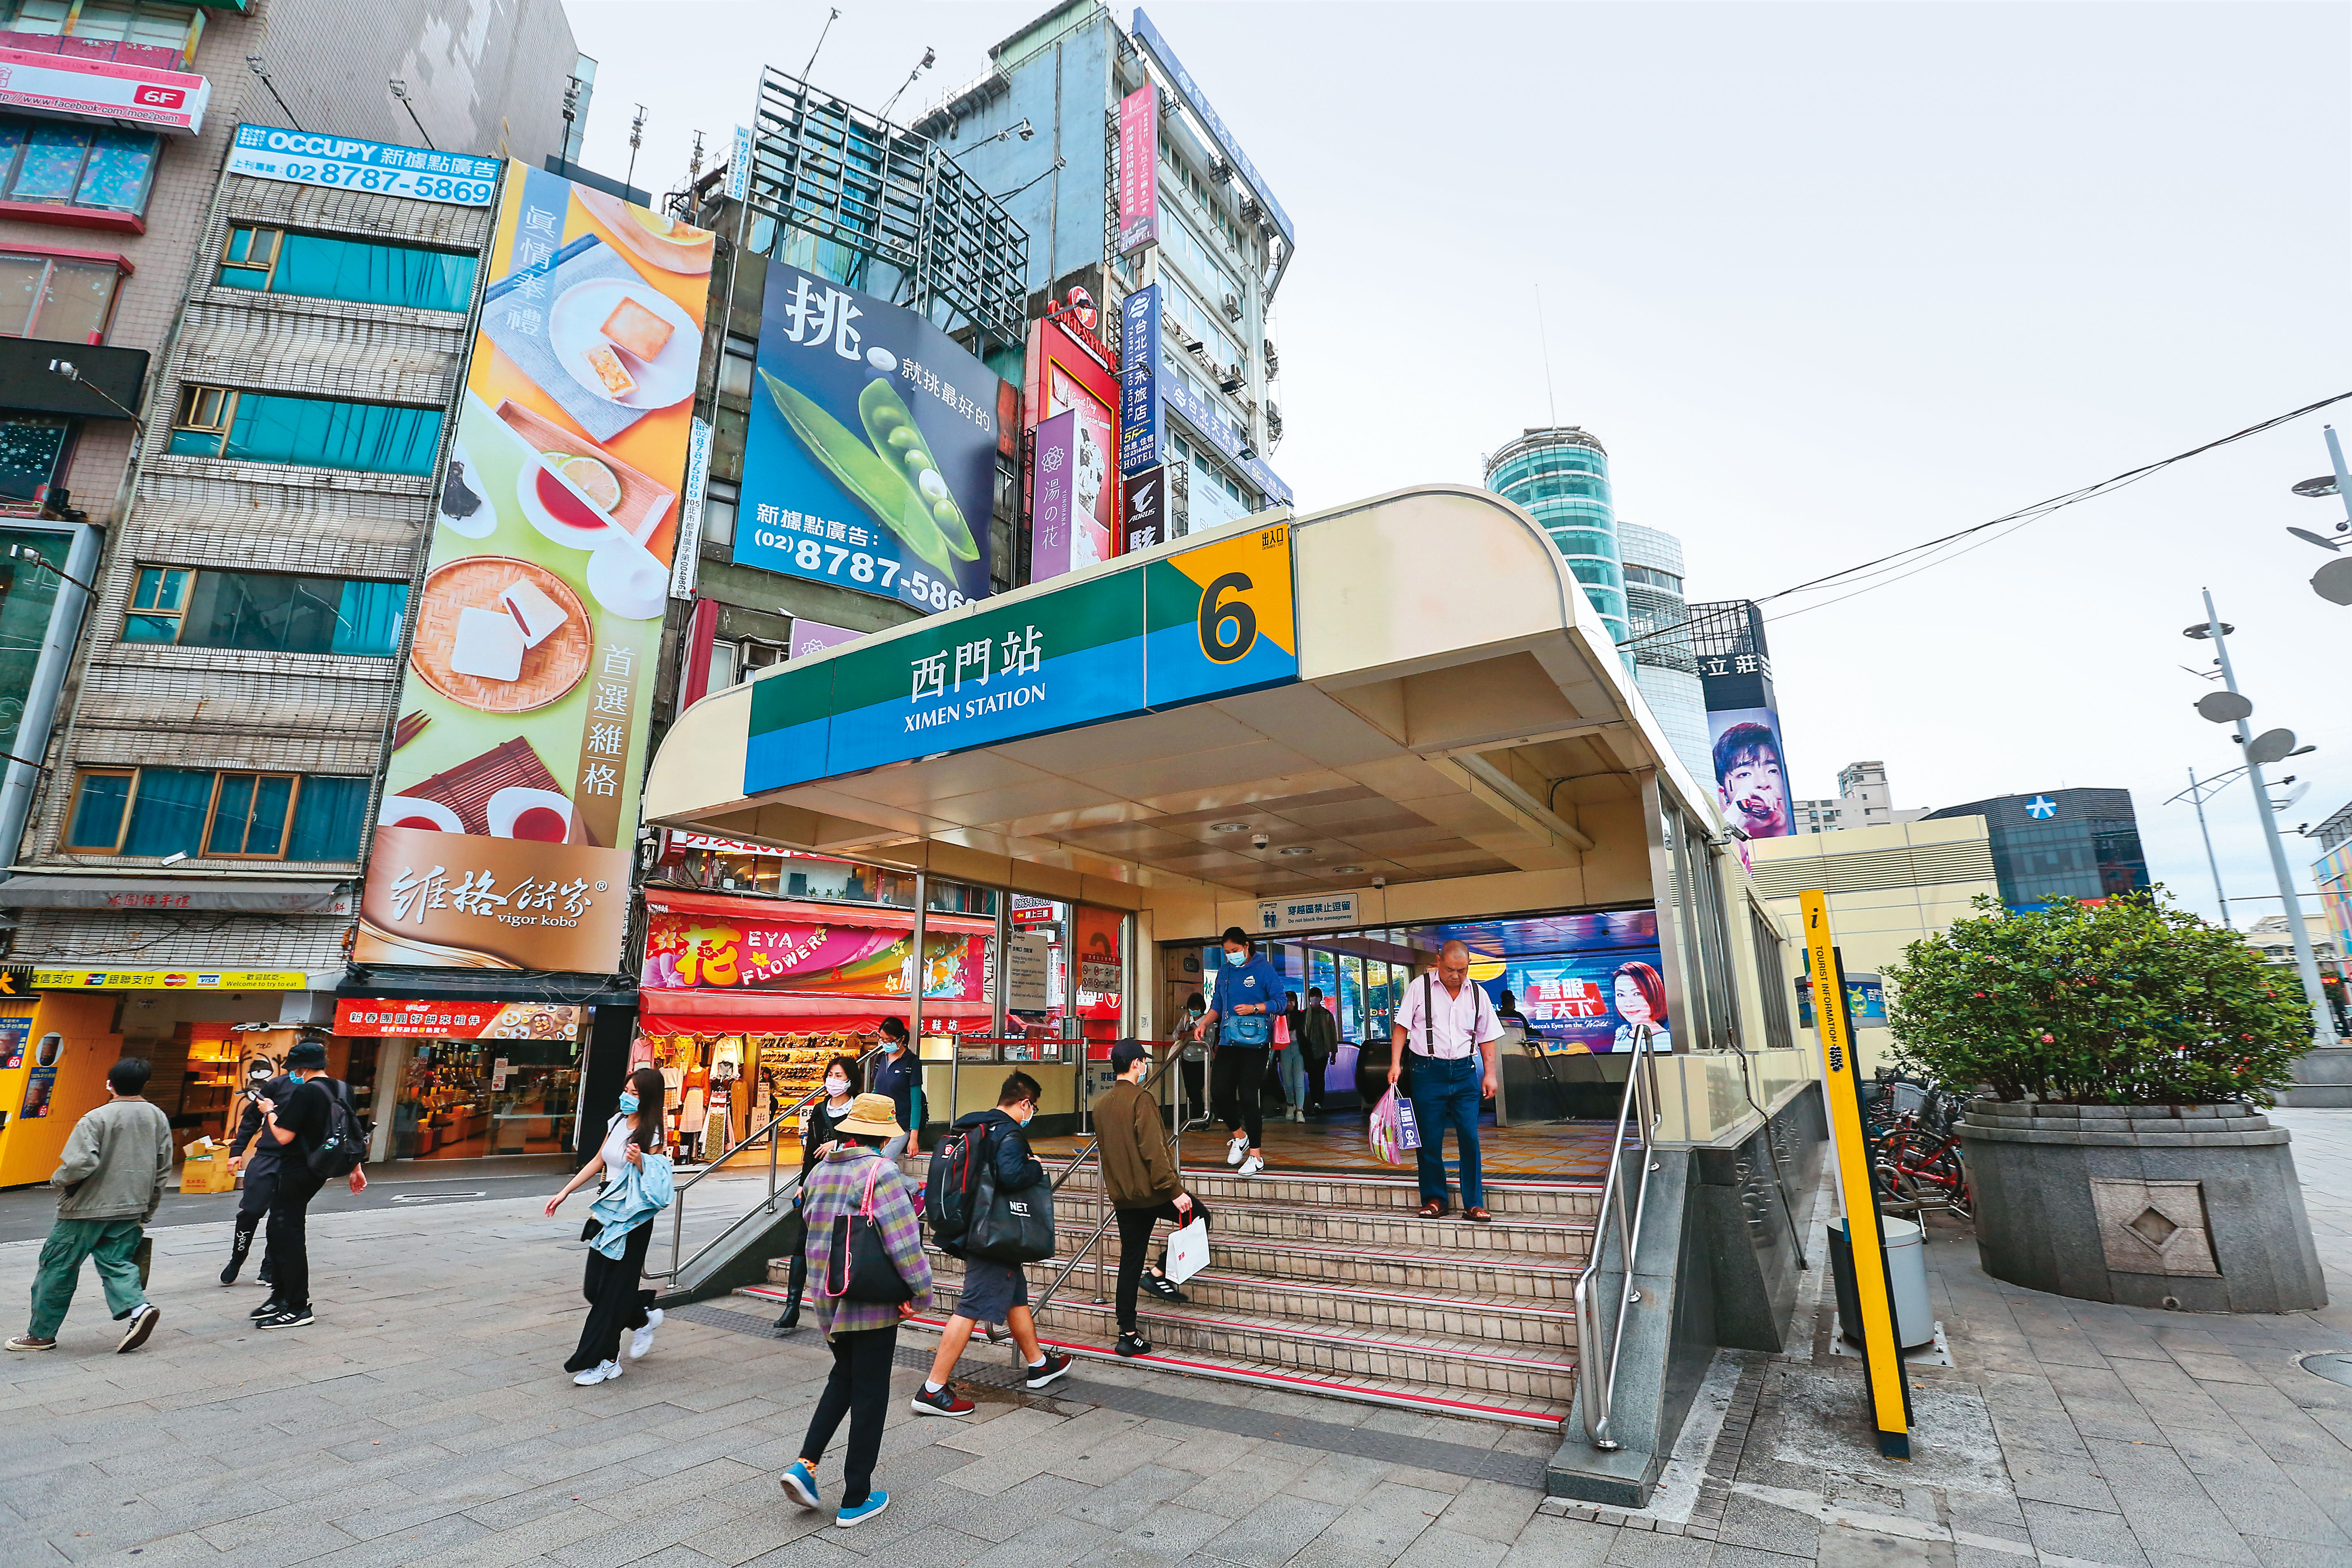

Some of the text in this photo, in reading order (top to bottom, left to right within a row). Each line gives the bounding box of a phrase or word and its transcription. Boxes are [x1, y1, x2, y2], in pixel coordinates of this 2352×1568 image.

[144, 90, 177, 103] 6F
[268, 131, 378, 162] OCCUPY
[286, 163, 316, 181] 02
[320, 163, 491, 203] 8787-5869
[782, 275, 864, 361] 挑
[1063, 326, 1106, 365] CREAMERY
[1079, 327, 1117, 374] STONE
[1134, 319, 1148, 422] 台北天禾旅店
[901, 357, 990, 433] 就挑最好的
[1071, 391, 1086, 407] Great
[1086, 397, 1097, 412] Day
[1136, 419, 1151, 427] STATION
[1192, 414, 1211, 435] TAIPEI
[1211, 433, 1229, 452] TIMHO
[1123, 434, 1154, 453] 休息 住宿
[1123, 450, 1154, 470] HOTEL
[1041, 478, 1061, 550] 湯の花
[1128, 507, 1156, 524] AORUS
[1262, 527, 1284, 547] 出入口
[754, 529, 977, 612] (02) 8787-586
[1200, 572, 1256, 661] 6
[910, 624, 1044, 704] 西門站
[903, 682, 1046, 733] XIMEN STATION
[581, 643, 636, 798] 首選維格
[390, 864, 593, 925] 維格餅家
[1025, 909, 1049, 919] 請上三樓
[1287, 901, 1350, 915] 穿越區禁止逗留
[1810, 908, 1819, 929] i
[497, 912, 578, 928] vigor kobo
[748, 930, 794, 948] EYA
[676, 923, 741, 986] 花
[741, 934, 822, 986] FLOWER
[1815, 945, 1828, 981] TOURIST
[108, 974, 155, 985] 銀聯支付
[1539, 978, 1586, 1000] 慧眼
[349, 1011, 481, 1026] 新春團圓好餅來相伴
[1534, 999, 1596, 1020] 看天下
[1821, 981, 1838, 1042] INFORMATION
[1584, 1020, 1609, 1028] World
[9, 1059, 20, 1067] 60
[39, 1107, 47, 1116] 60
[1009, 1201, 1028, 1212] NET
